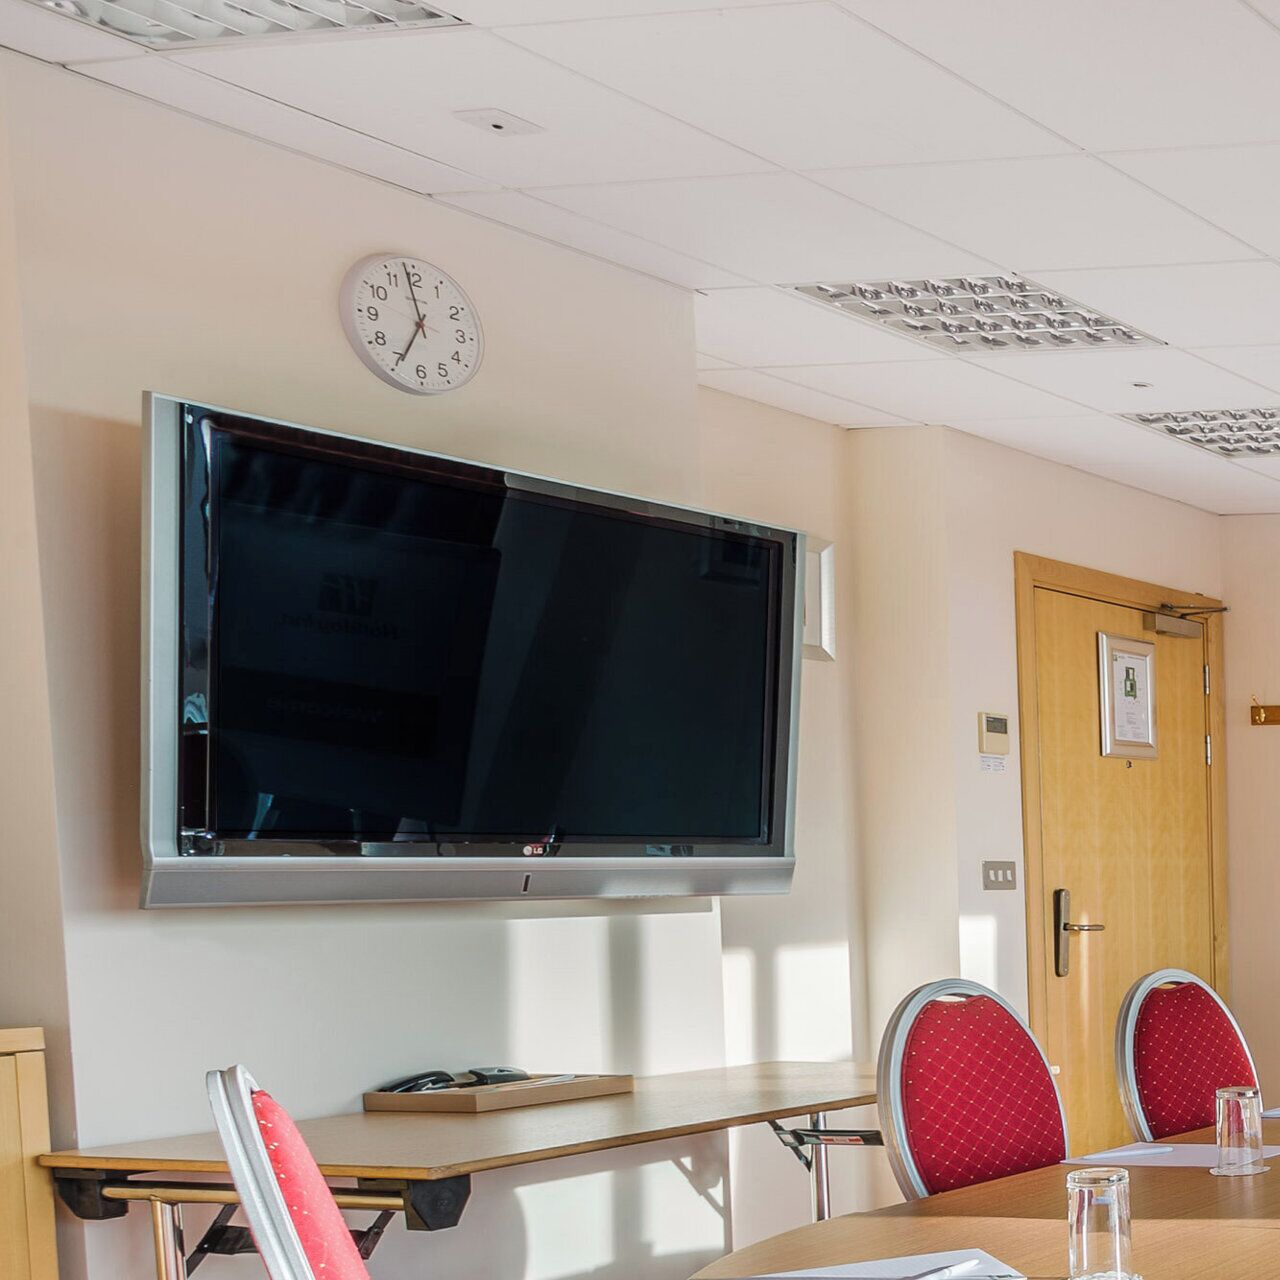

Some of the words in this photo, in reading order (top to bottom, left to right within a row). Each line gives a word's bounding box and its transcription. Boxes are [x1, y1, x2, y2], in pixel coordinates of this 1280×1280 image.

[386, 271, 399, 288] 11
[369, 284, 388, 301] 10
[434, 284, 440, 299] 1
[367, 306, 379, 321] 9
[449, 305, 460, 321] 2
[374, 331, 387, 346] 8
[455, 329, 466, 344] 3
[392, 351, 404, 366] 7
[451, 350, 462, 365] 4
[416, 364, 427, 379] 6
[437, 362, 448, 377] 5
